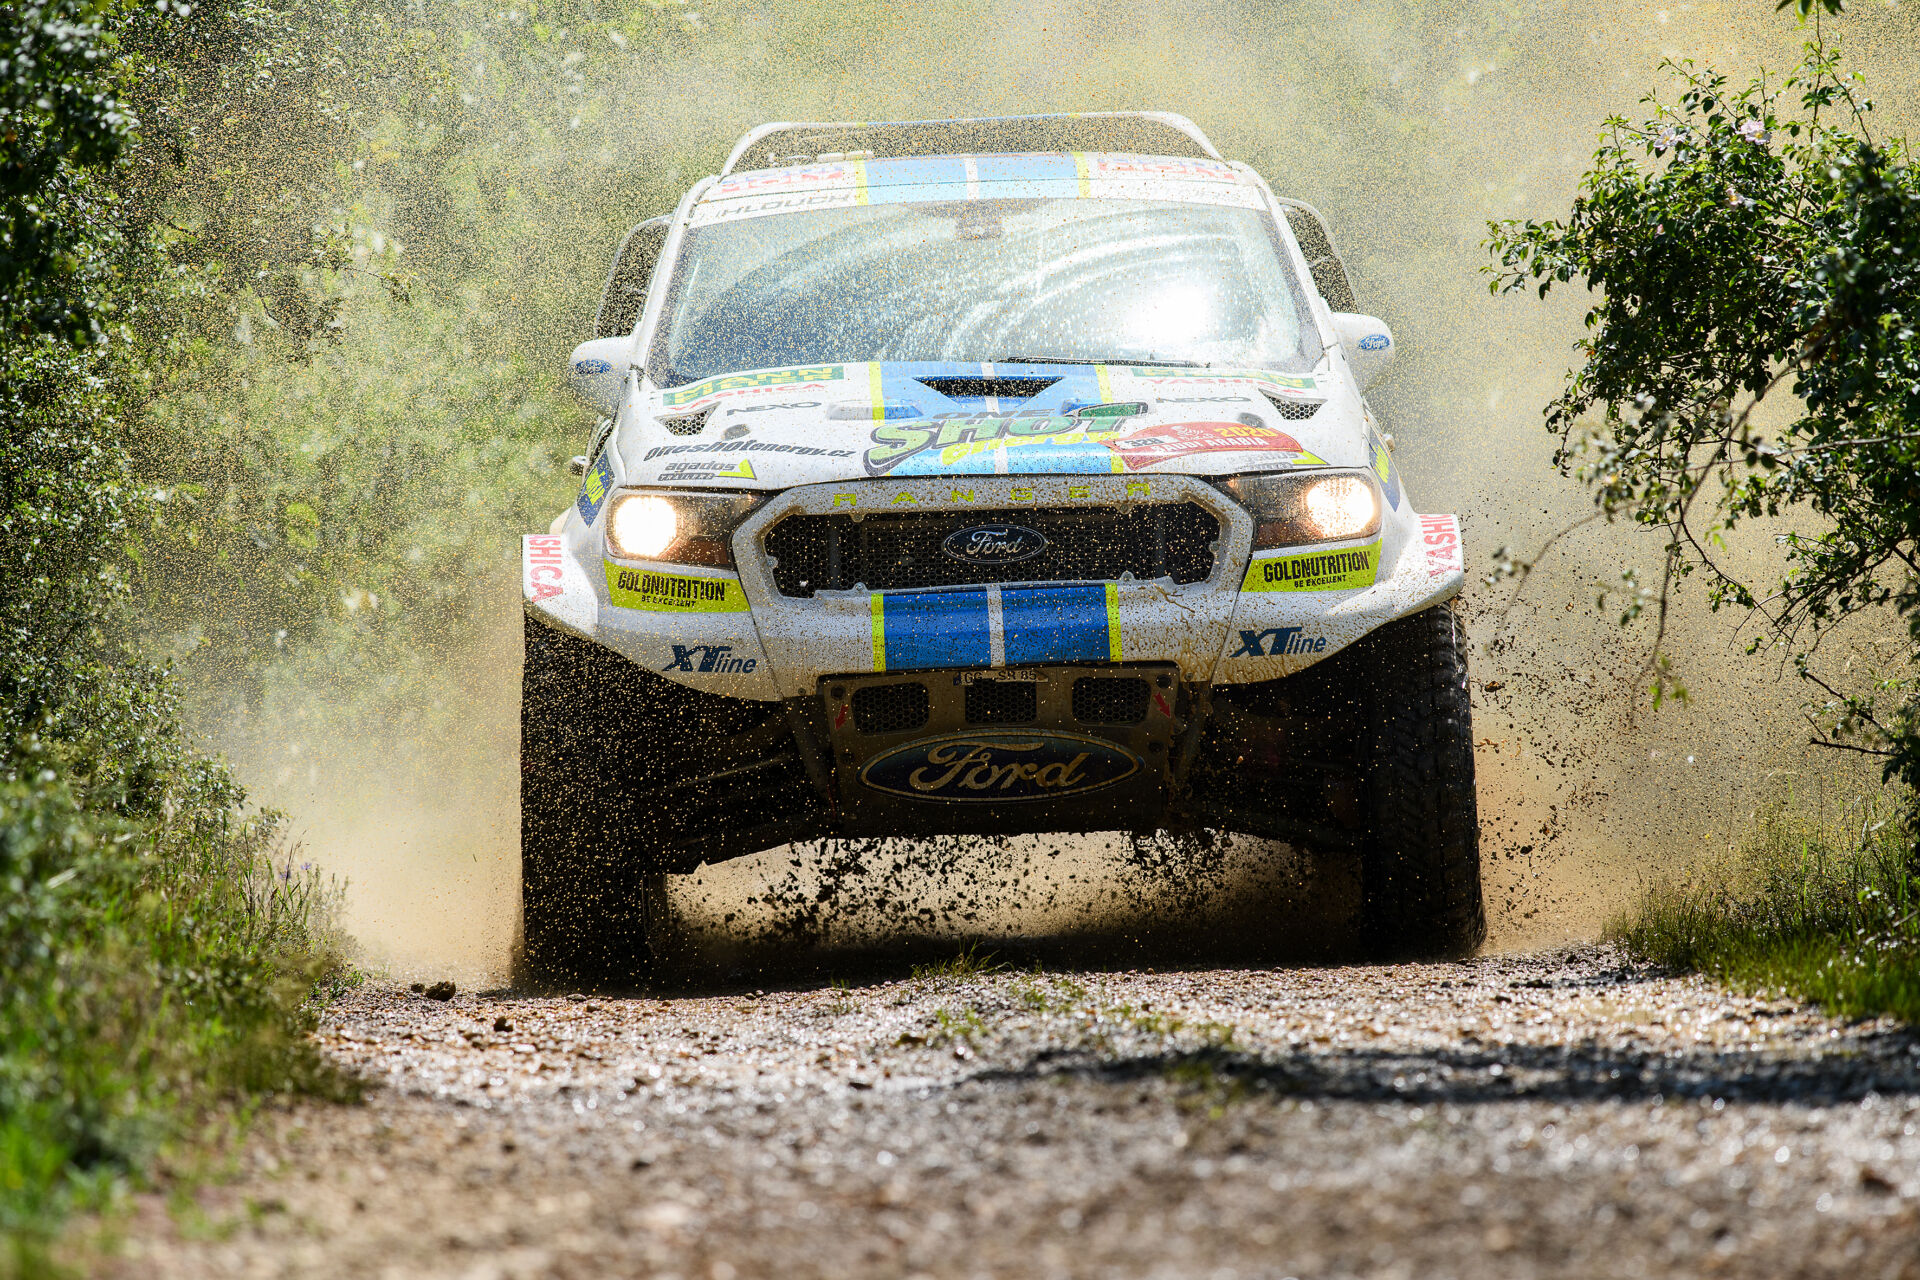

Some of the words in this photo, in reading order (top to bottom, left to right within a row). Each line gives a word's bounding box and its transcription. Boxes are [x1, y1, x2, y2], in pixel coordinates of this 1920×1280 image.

[933, 408, 1056, 419] ONE
[1215, 426, 1279, 438] 2020
[643, 439, 857, 462] oneshotenergy.cz
[1150, 440, 1207, 452] SAUDI
[1211, 437, 1269, 449] ARABIA
[664, 460, 739, 472] agados
[834, 482, 1151, 506] RANGER
[965, 530, 1023, 555] Ford
[1264, 550, 1370, 583] GOLDNUTRITION
[617, 570, 726, 602] GOLDNUTRITION
[1294, 579, 1304, 588] BE
[1305, 575, 1347, 587] EXCELLENT
[641, 595, 651, 604] BE
[652, 596, 697, 608] EXCELLENT
[1020, 670, 1037, 681] 85
[908, 741, 1091, 791] Ford
